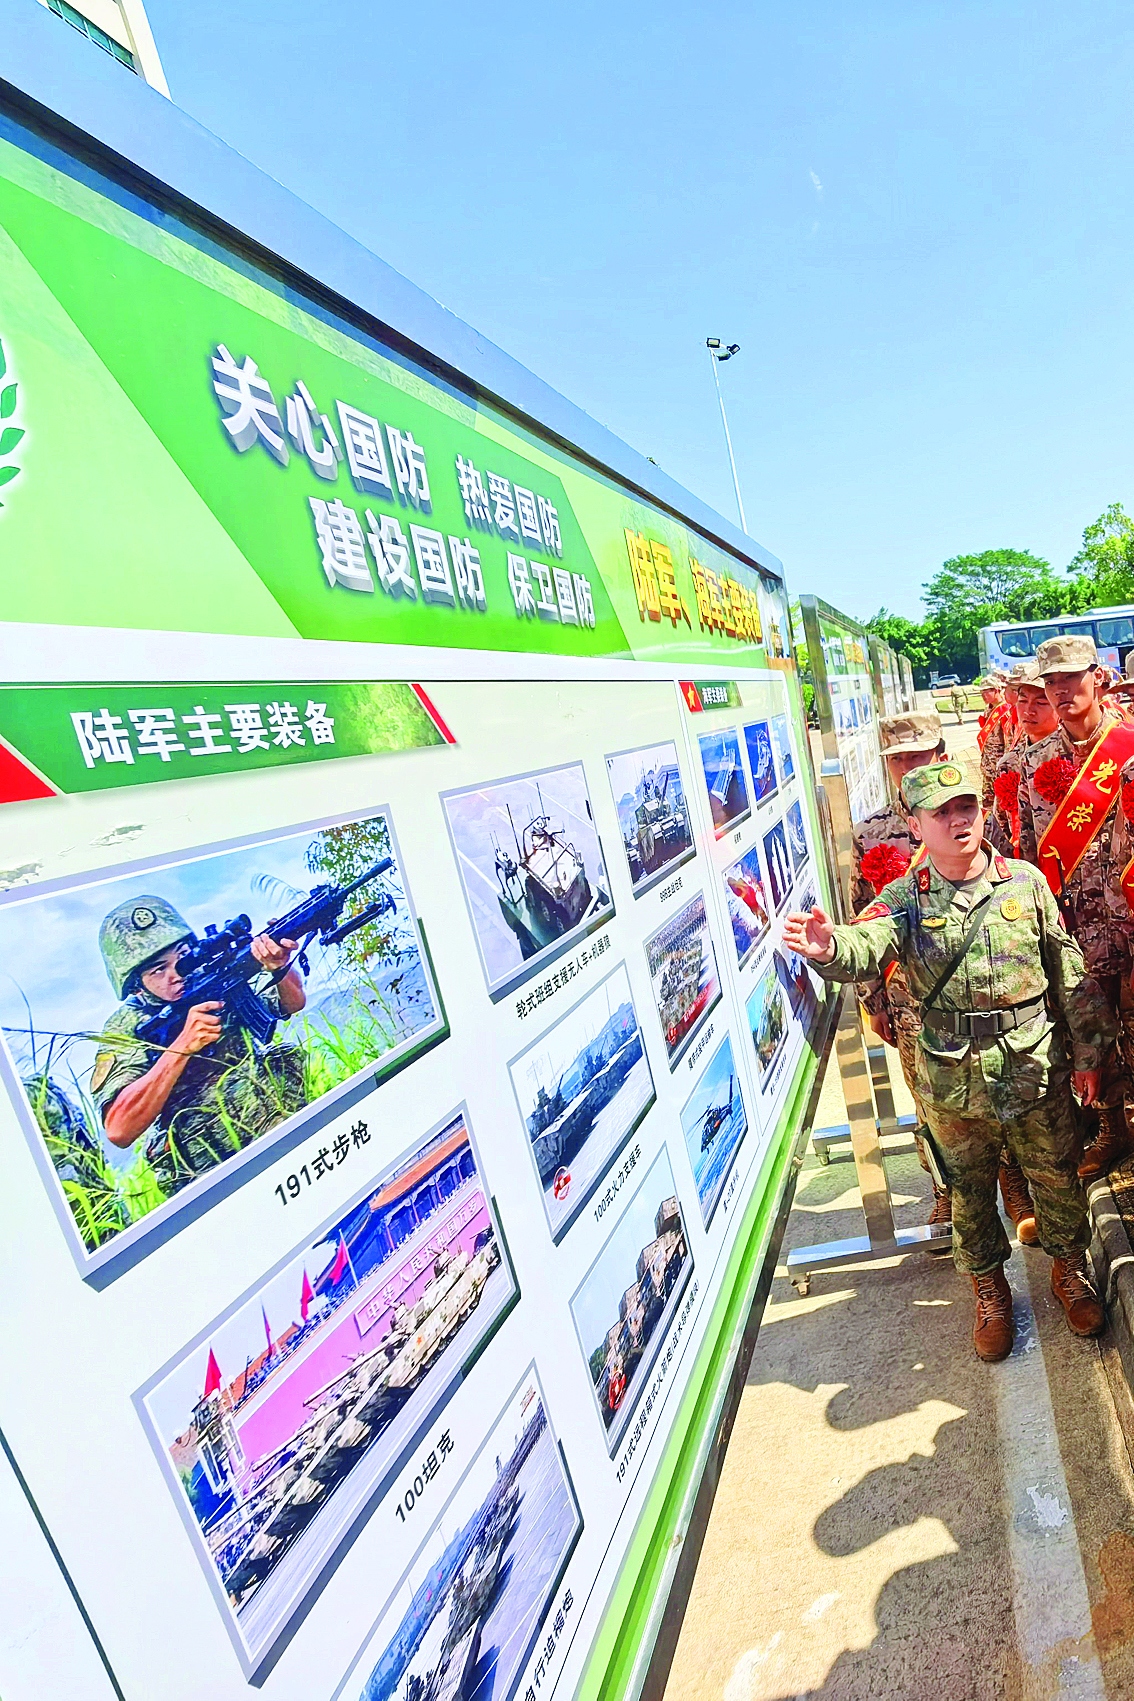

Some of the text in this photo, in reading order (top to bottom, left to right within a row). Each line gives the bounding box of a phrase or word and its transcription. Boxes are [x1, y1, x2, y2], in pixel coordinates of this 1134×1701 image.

[210, 343, 564, 558] 关心国防 热爱国防
[307, 495, 597, 628] 建设国防 保卫国防
[69, 700, 336, 770] 陆军主要装备
[273, 1119, 372, 1207] 191式步枪
[593, 1143, 642, 1223] 100式火力支援车
[395, 1427, 455, 1523] 100坦克
